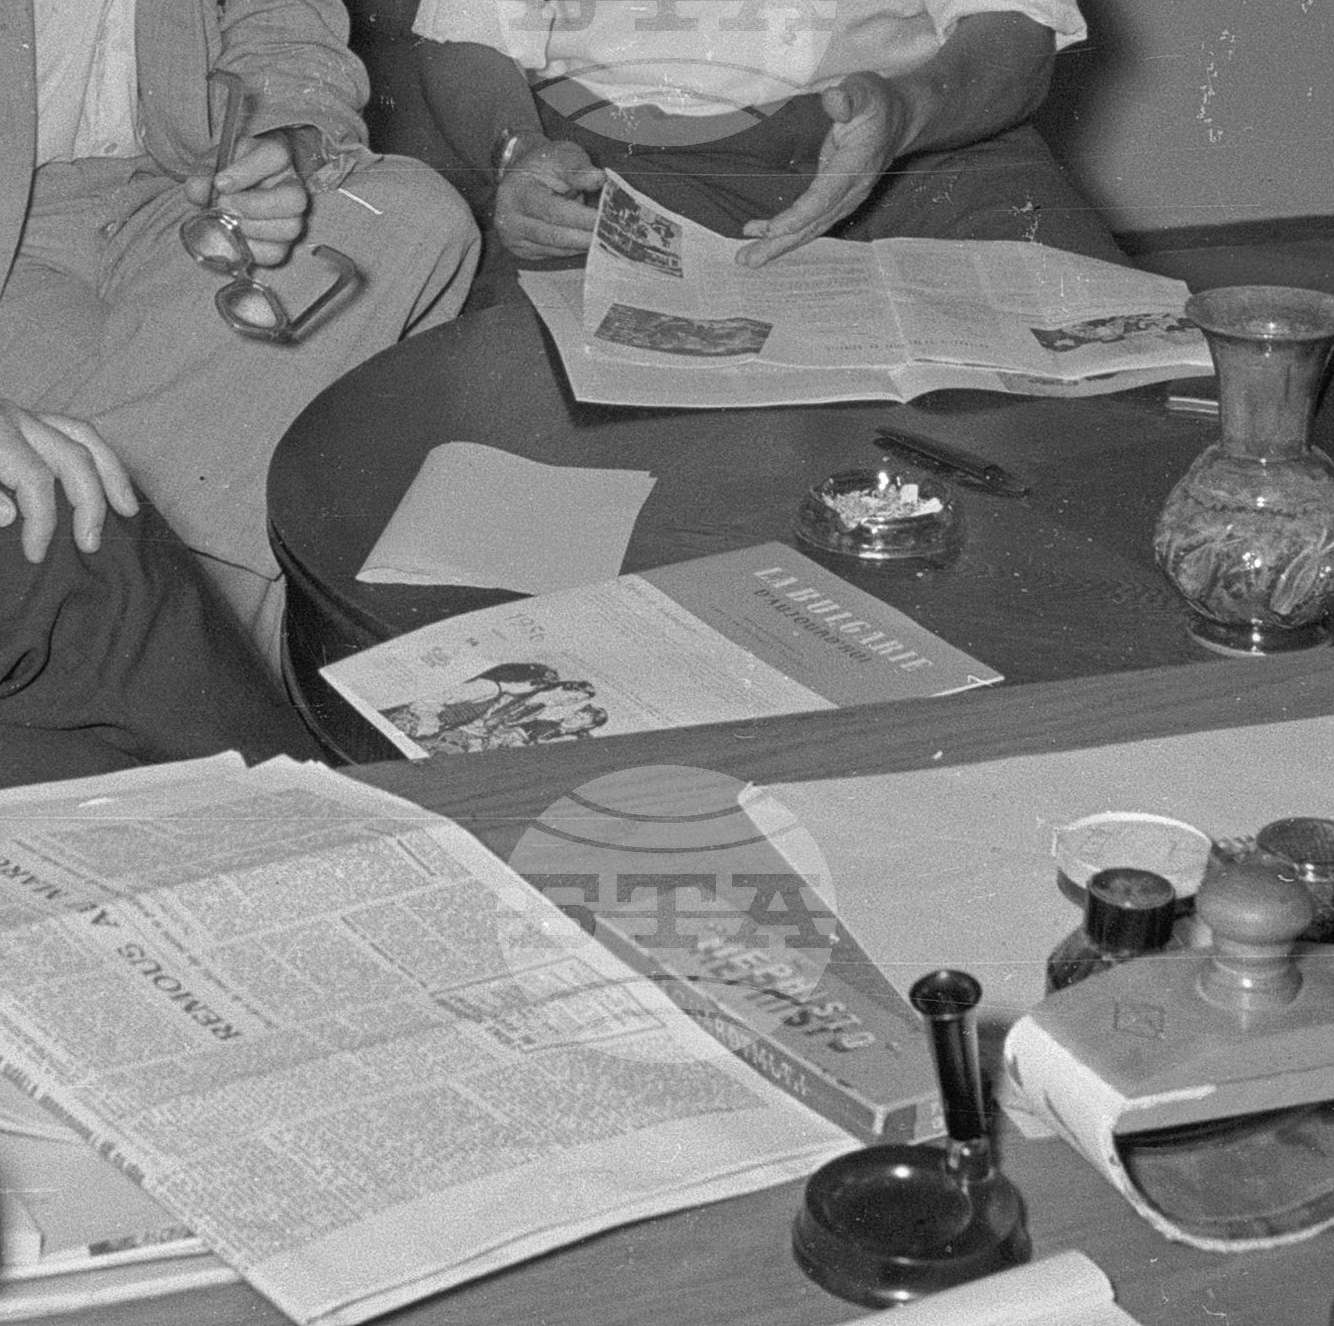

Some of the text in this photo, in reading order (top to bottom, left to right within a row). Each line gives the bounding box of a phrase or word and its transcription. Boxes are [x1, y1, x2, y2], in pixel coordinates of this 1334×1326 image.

[752, 566, 799, 589] LA
[785, 587, 934, 673] BULGARIE
[118, 943, 242, 1041] REMOUS
